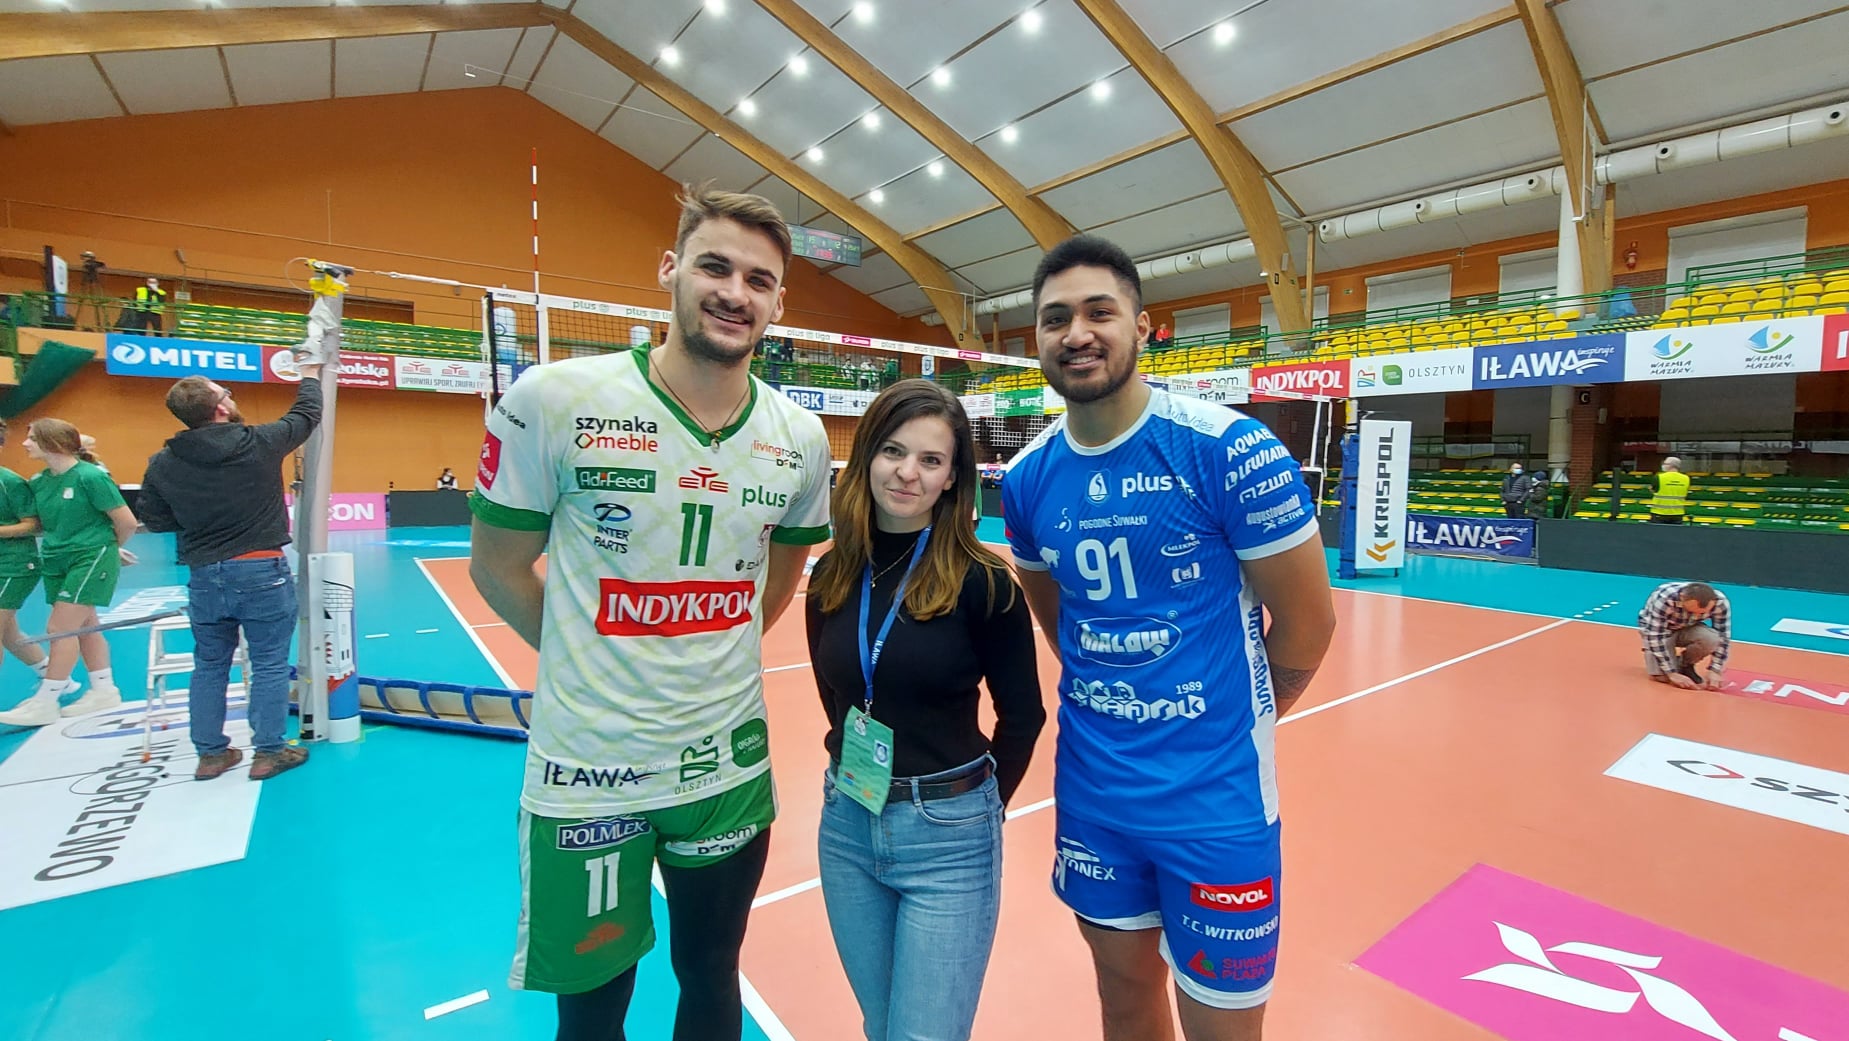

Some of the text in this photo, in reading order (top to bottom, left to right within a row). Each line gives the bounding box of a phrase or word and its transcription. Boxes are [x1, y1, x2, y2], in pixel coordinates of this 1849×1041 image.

[572, 301, 596, 311] plus
[625, 307, 648, 317] plus
[150, 347, 257, 371] MITEL
[1481, 349, 1584, 380] IŁAWA
[1650, 360, 1692, 368] WARMIA
[1744, 361, 1792, 370] MAZURY
[1745, 353, 1793, 363] WARMIA
[1257, 369, 1344, 391] INDYKPOL
[1408, 364, 1465, 379] OLSZTYN
[1650, 367, 1691, 375] MAZURY
[401, 377, 433, 387] UPRAWIAJ
[788, 391, 822, 409] DBK
[576, 416, 657, 434] szynaka
[597, 433, 658, 452] meble
[1122, 472, 1173, 498] plus
[1374, 427, 1394, 538] KRISPOL
[742, 485, 787, 507] plus
[597, 525, 629, 541] INTER
[679, 502, 714, 567] 11
[1407, 521, 1501, 549] IŁAWA
[594, 536, 628, 553] PARTS
[1075, 537, 1138, 601] 91
[1175, 681, 1203, 695] 1989
[543, 761, 640, 788] IŁAWA
[674, 774, 722, 796] OLSZTYN
[1749, 776, 1849, 814] SZ
[561, 819, 648, 847] POLMLEK
[585, 852, 620, 917] 11
[1200, 888, 1268, 905] NOVOL
